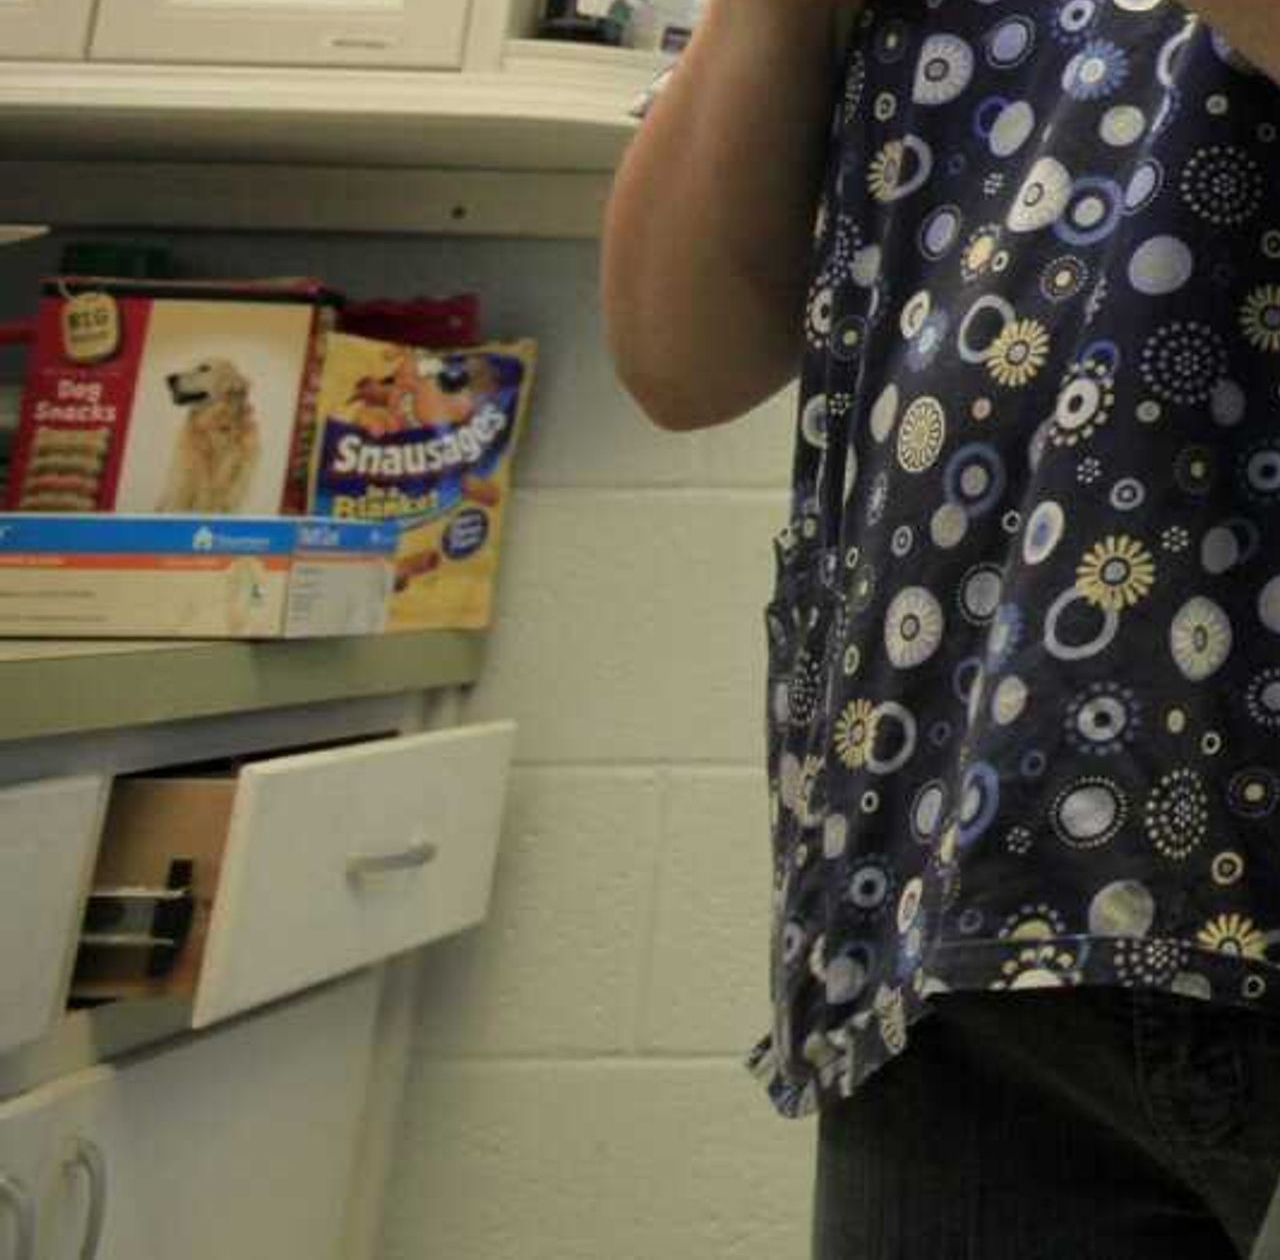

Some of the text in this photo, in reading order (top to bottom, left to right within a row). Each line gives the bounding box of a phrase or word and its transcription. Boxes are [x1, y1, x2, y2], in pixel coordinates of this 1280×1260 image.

[57, 380, 102, 403] Dog
[34, 401, 117, 423] Snacks
[333, 403, 506, 476] Snausages
